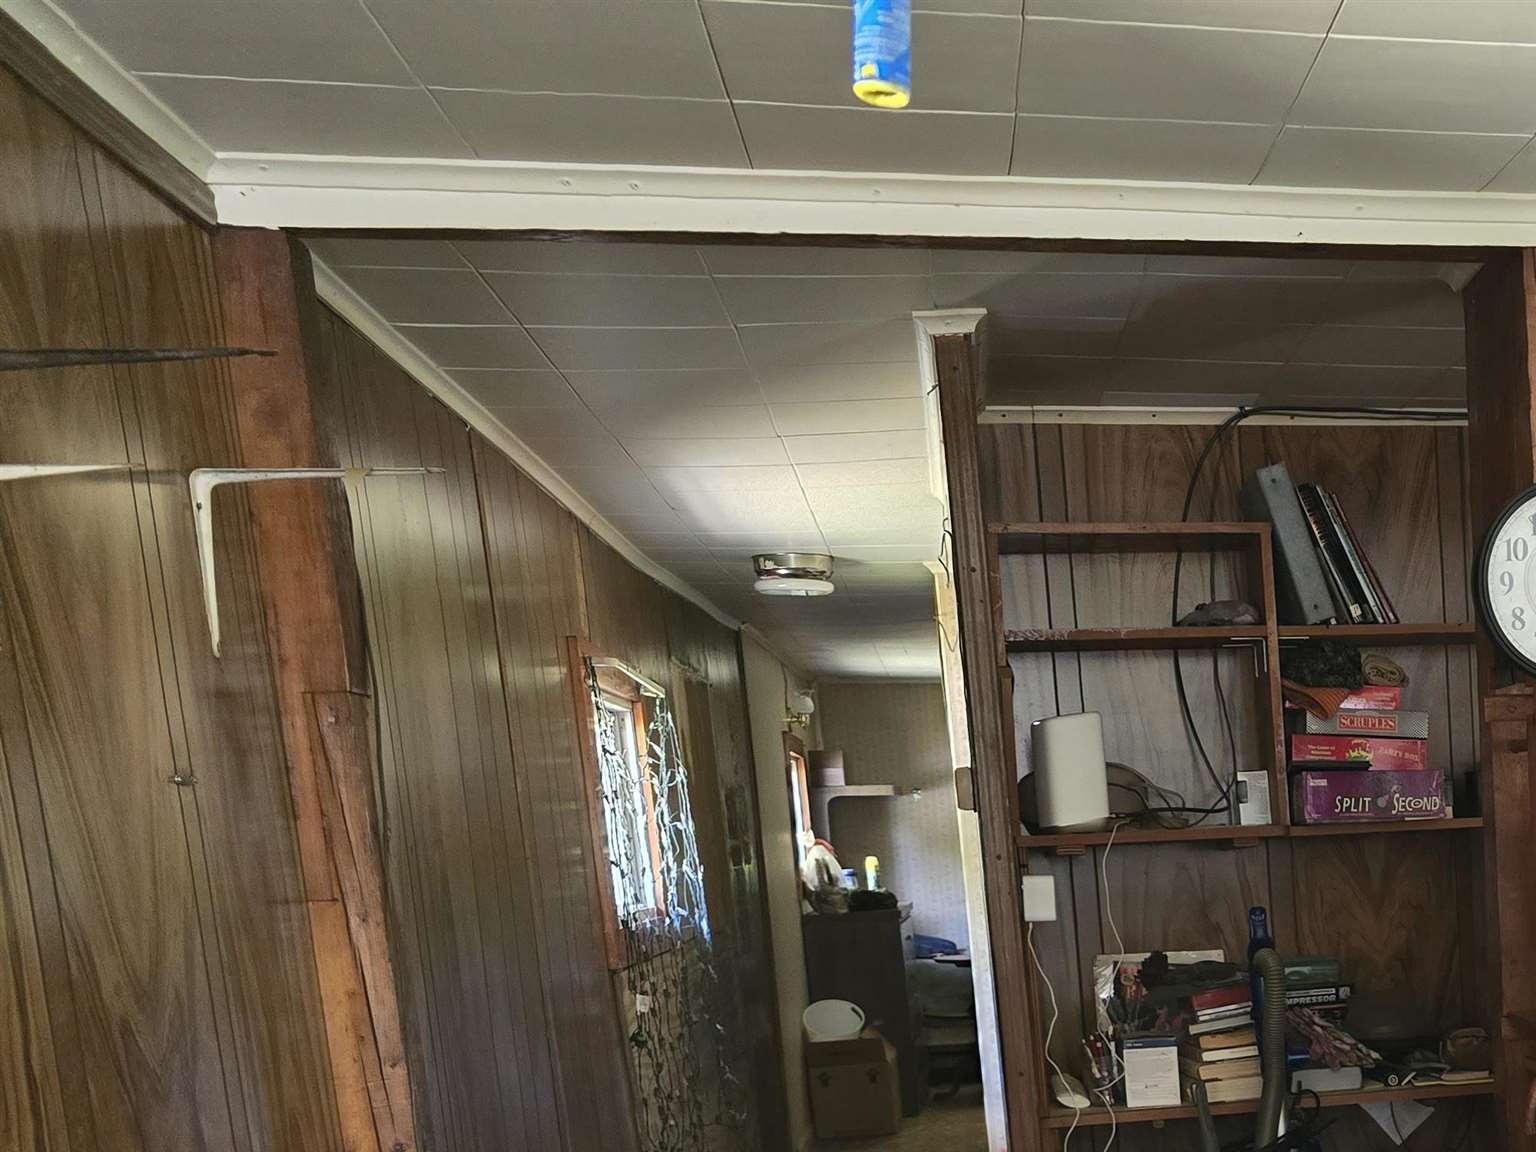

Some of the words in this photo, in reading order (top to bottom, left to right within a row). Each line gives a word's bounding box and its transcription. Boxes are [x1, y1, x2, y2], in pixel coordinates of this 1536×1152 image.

[1503, 537, 1528, 561] 10
[1500, 571, 1514, 595] 9
[1511, 607, 1526, 631] 8
[1339, 714, 1396, 730] SCRUPLES
[1334, 795, 1372, 813] SPLIT
[1391, 793, 1441, 815] SECOND
